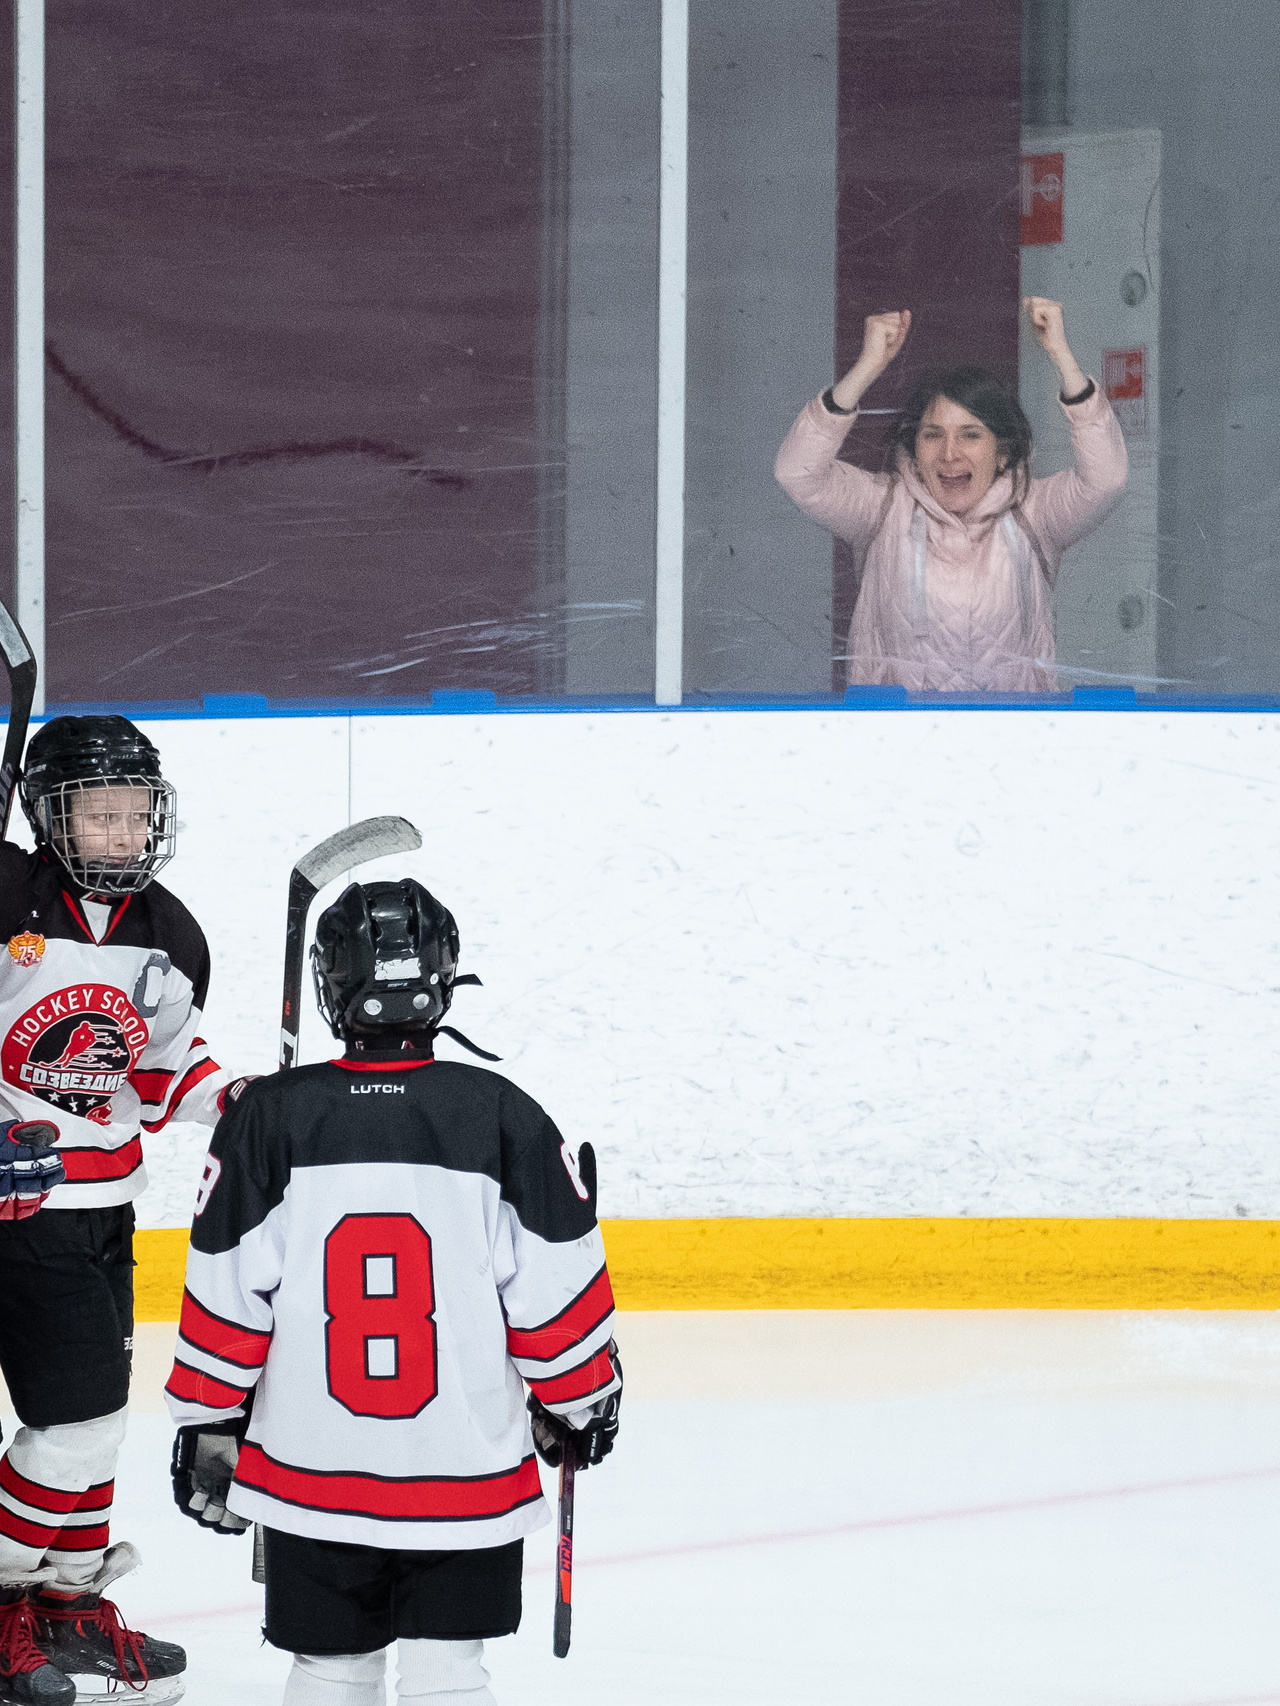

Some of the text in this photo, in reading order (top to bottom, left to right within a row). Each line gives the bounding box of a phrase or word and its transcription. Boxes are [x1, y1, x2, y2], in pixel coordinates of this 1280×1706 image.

[18, 945, 37, 960] 75
[11, 988, 94, 1048] HOCKEY
[350, 1084, 405, 1094] LUTCH
[323, 1212, 438, 1421] 8
